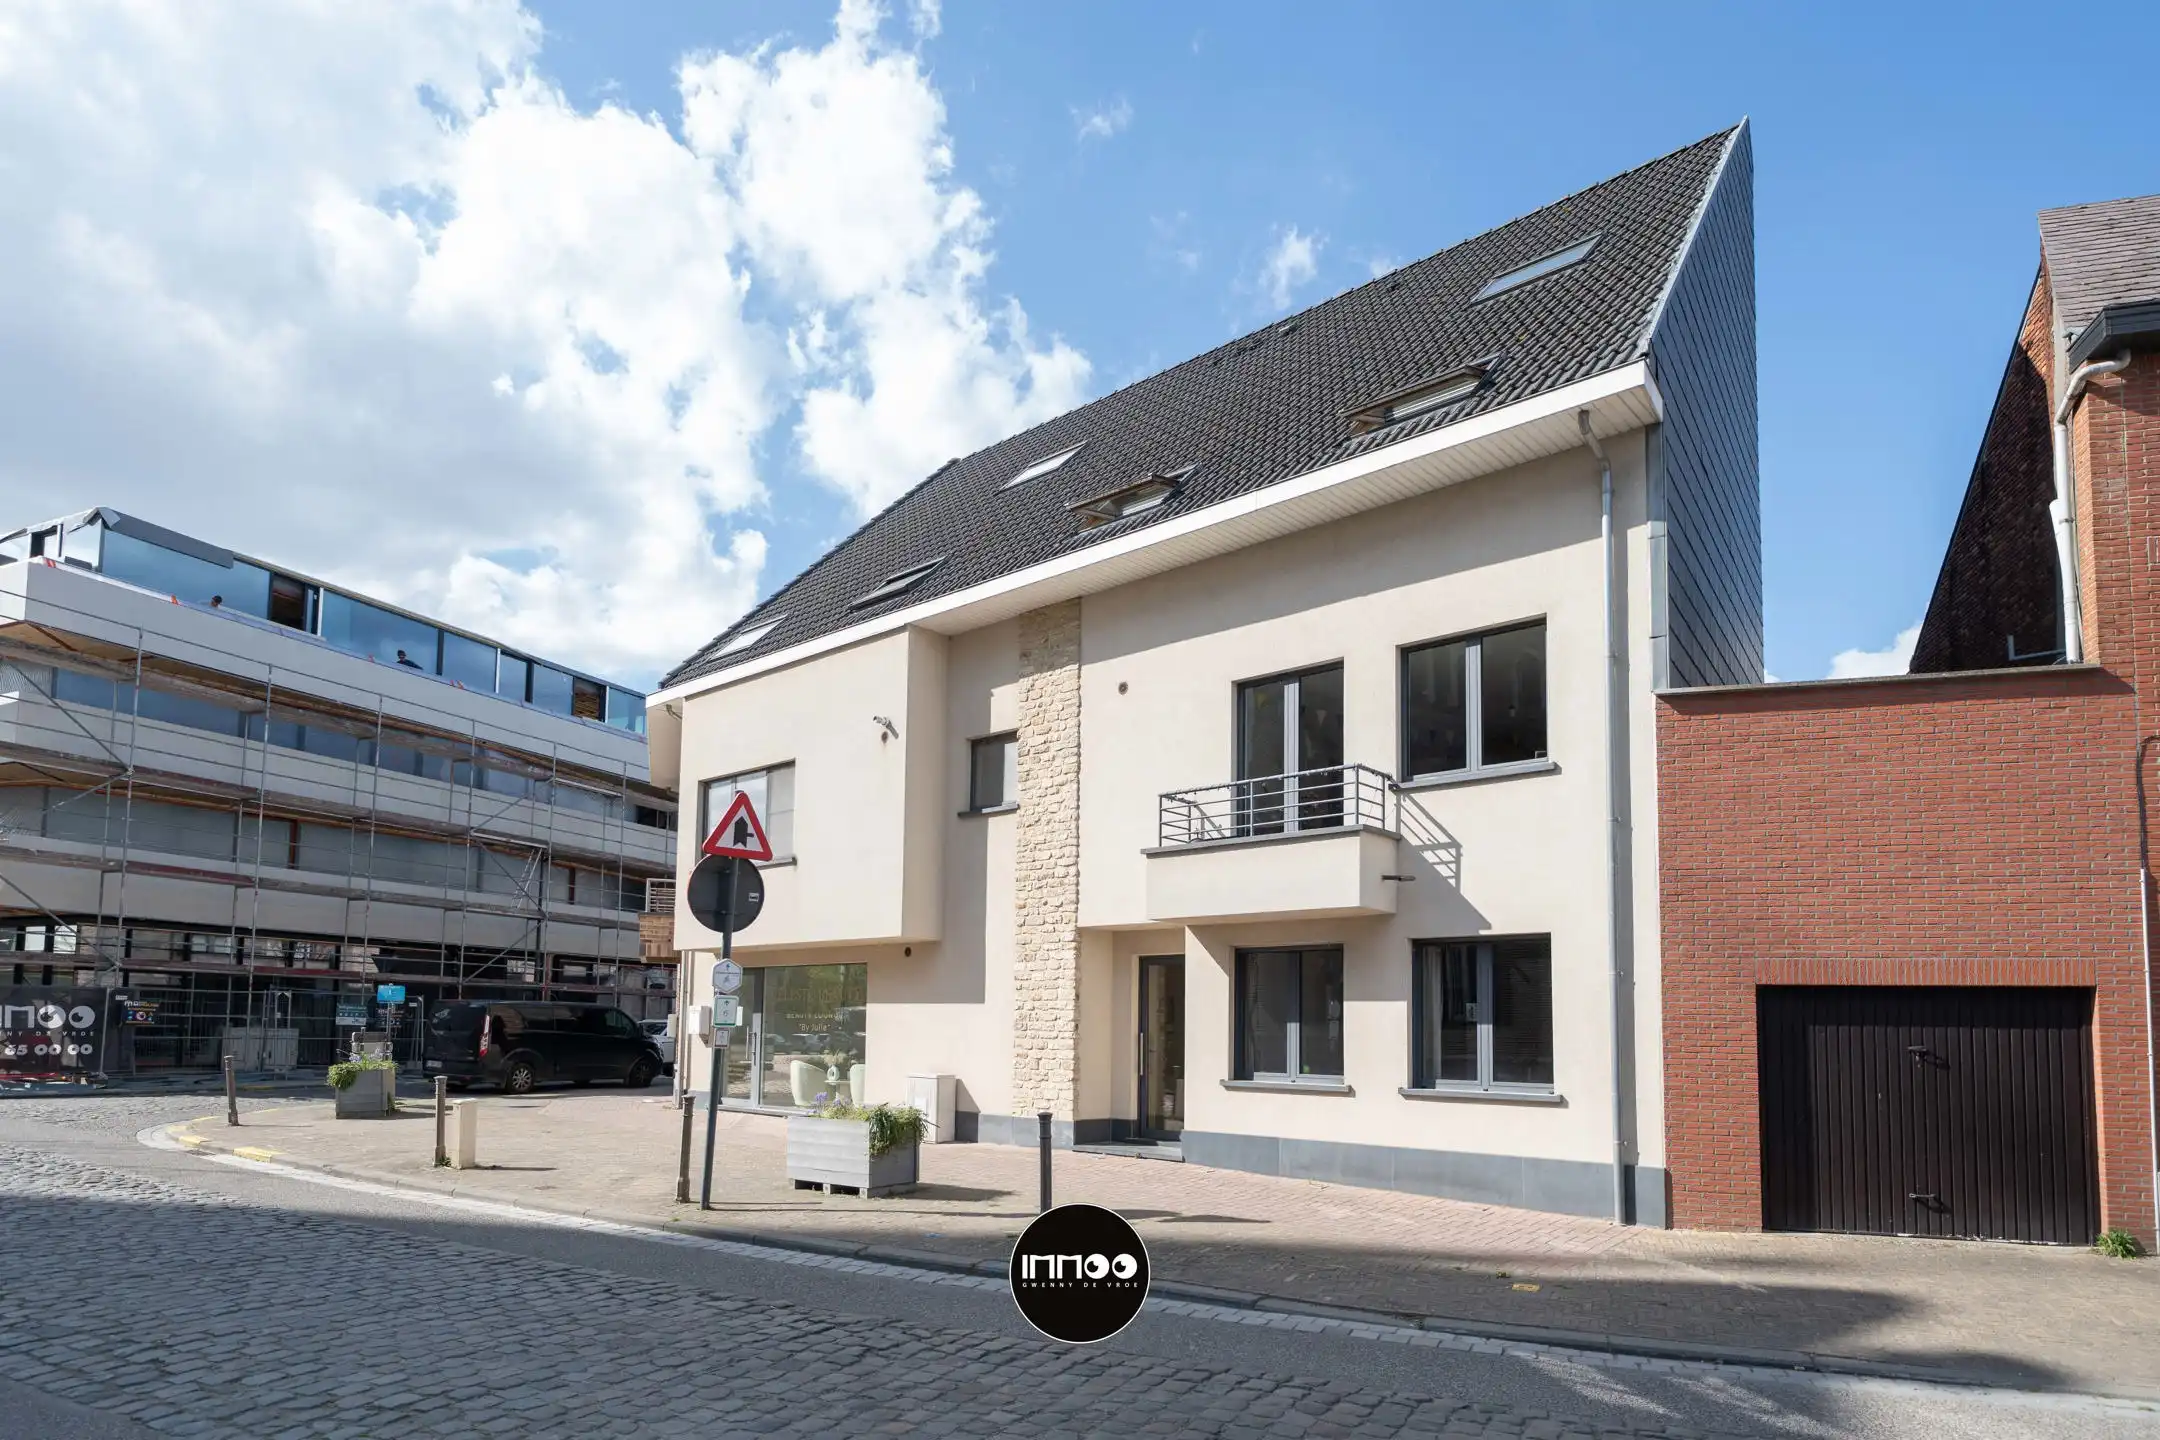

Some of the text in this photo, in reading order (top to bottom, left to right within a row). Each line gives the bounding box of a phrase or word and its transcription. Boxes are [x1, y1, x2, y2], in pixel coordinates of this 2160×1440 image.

[0, 1004, 96, 1029] MOO
[34, 1043, 62, 1056] 00
[67, 1043, 93, 1055] 00
